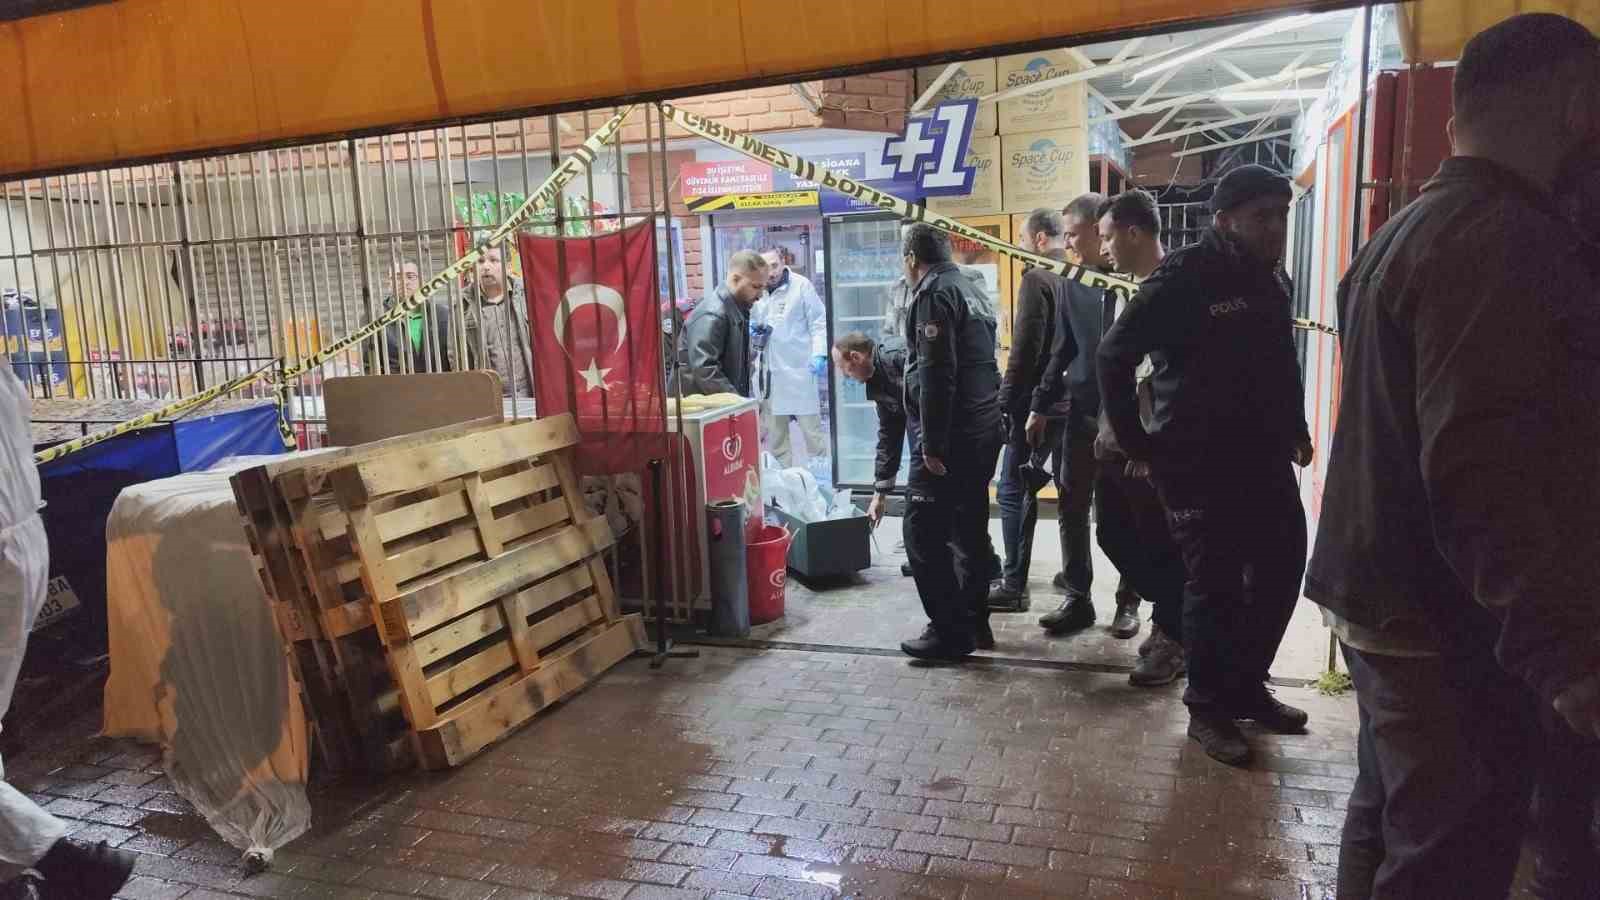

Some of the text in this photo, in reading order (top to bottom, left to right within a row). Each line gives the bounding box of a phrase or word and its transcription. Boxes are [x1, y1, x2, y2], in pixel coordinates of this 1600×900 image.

[961, 78, 984, 94] Cup
[887, 104, 969, 188] +1
[1011, 149, 1073, 168] Space Cup
